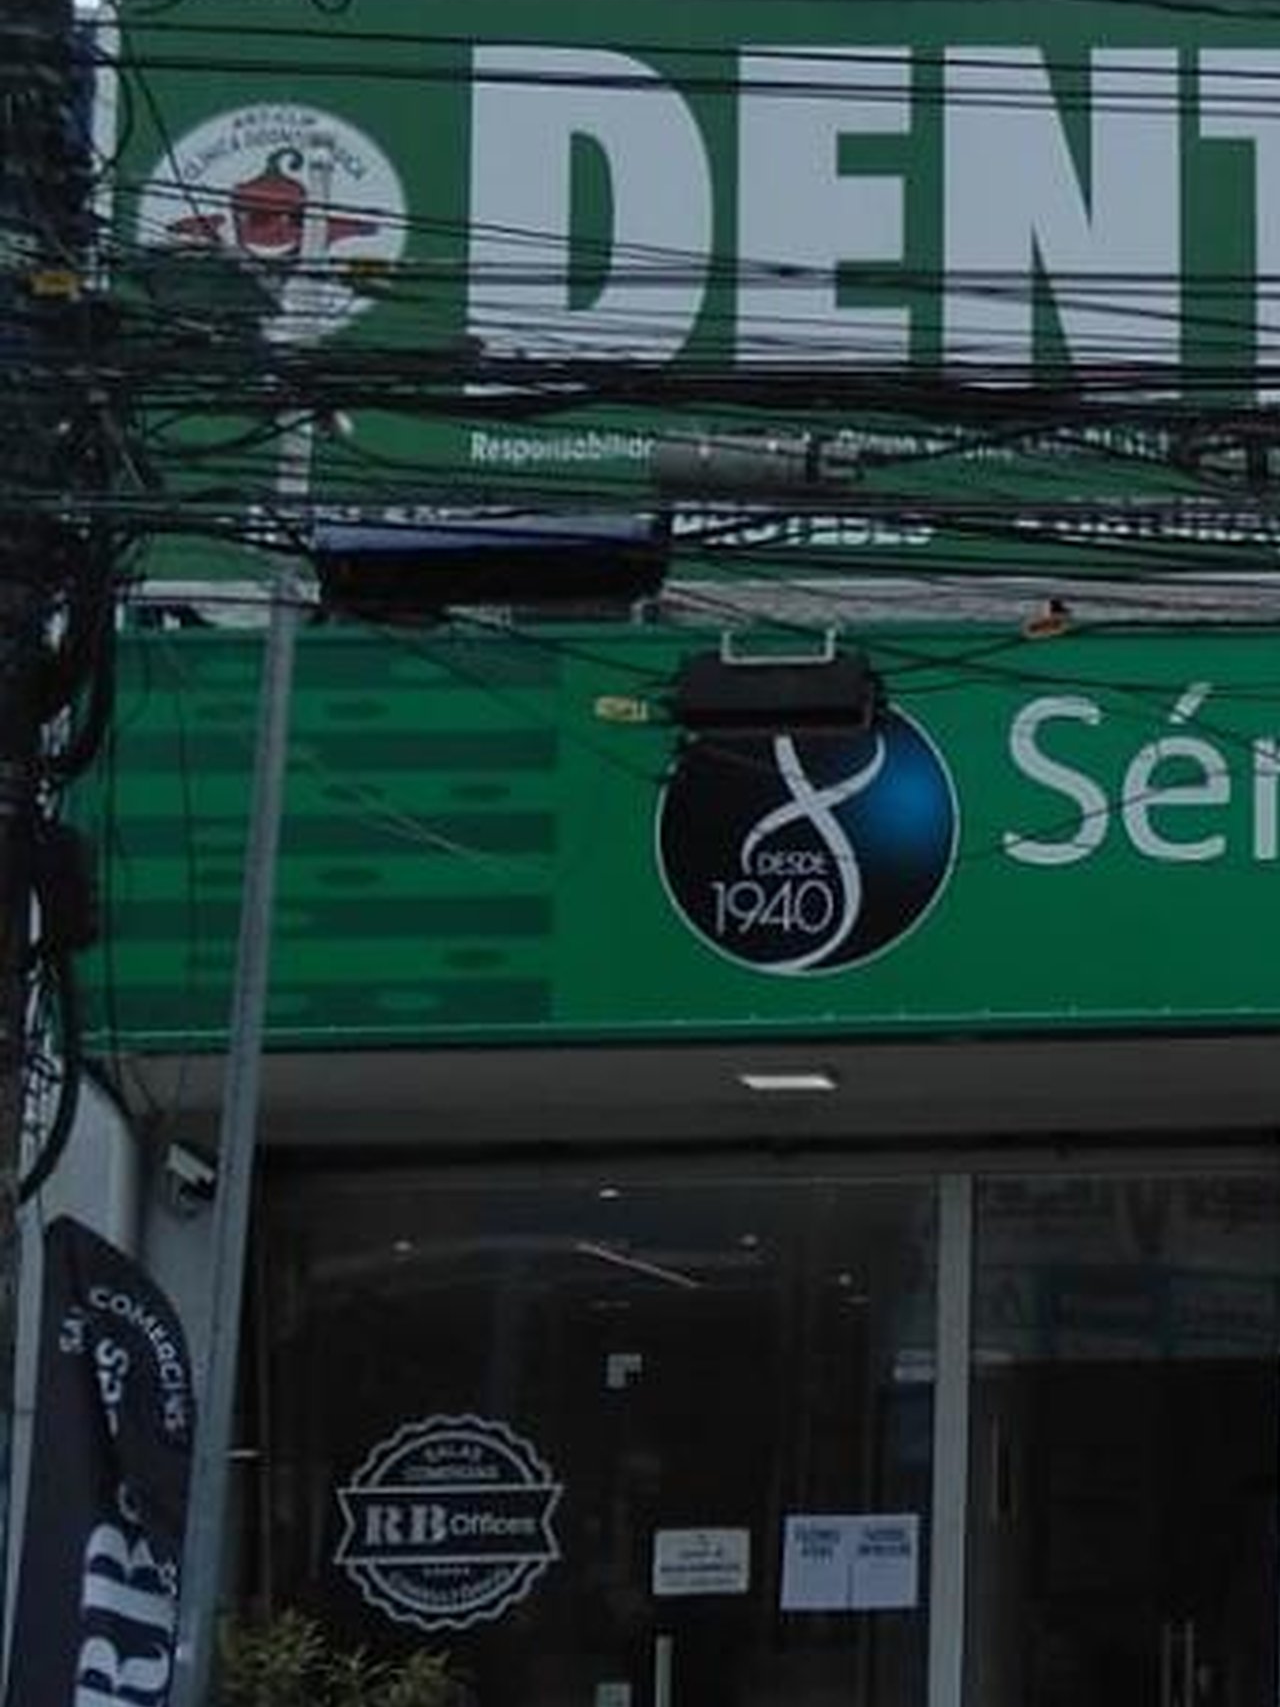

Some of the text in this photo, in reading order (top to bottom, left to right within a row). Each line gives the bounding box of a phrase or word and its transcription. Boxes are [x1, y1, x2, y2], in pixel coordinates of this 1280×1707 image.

[756, 849, 829, 876] DESDE
[711, 878, 834, 936] 1940
[364, 1503, 447, 1546] RB
